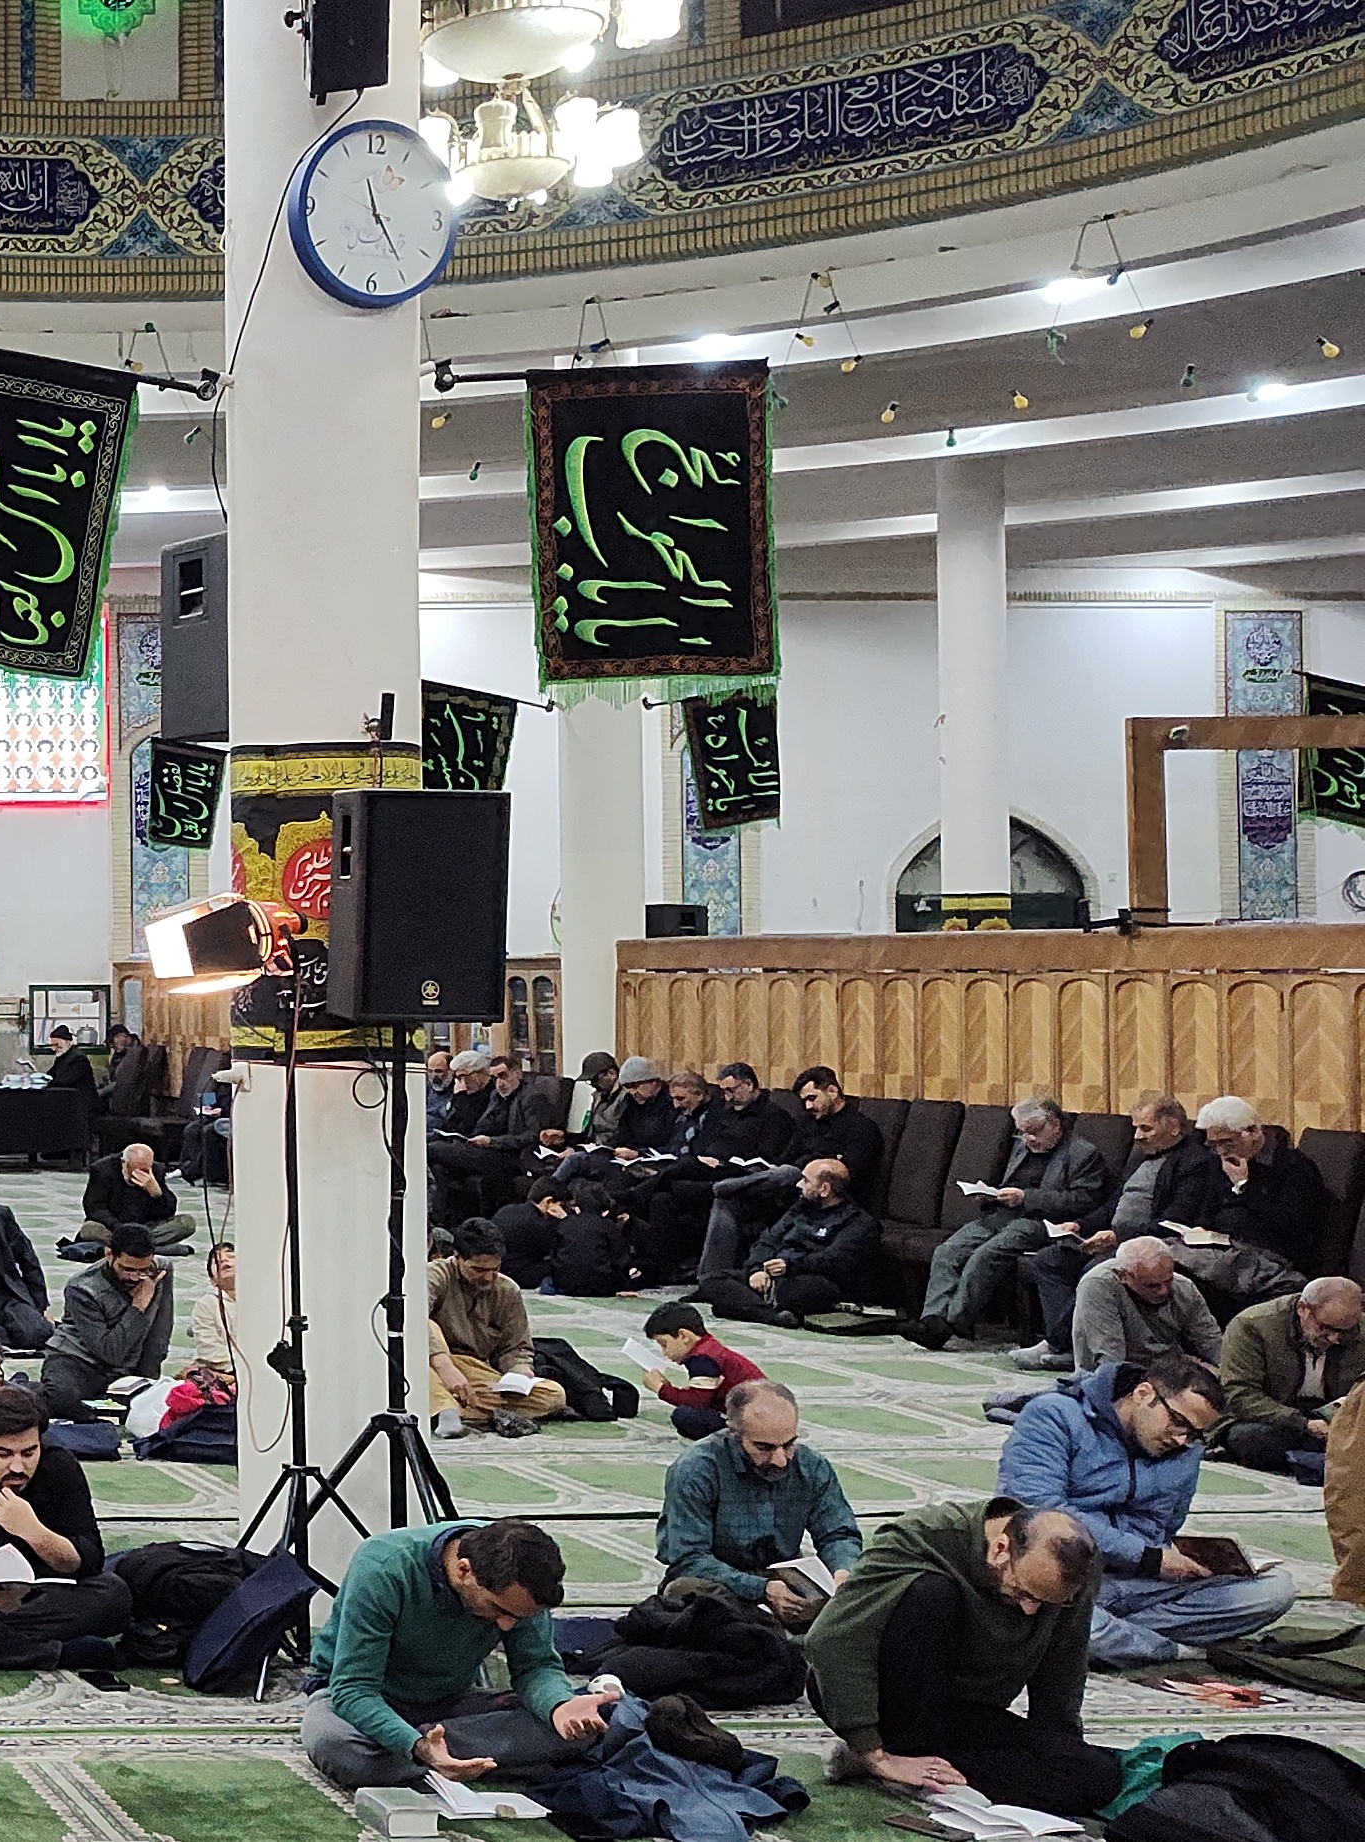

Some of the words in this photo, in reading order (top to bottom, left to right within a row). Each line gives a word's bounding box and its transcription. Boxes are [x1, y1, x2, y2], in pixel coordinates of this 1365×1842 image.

[366, 134, 387, 155] 12
[306, 196, 316, 217] 9
[432, 210, 443, 232] 3
[366, 272, 378, 293] 6
